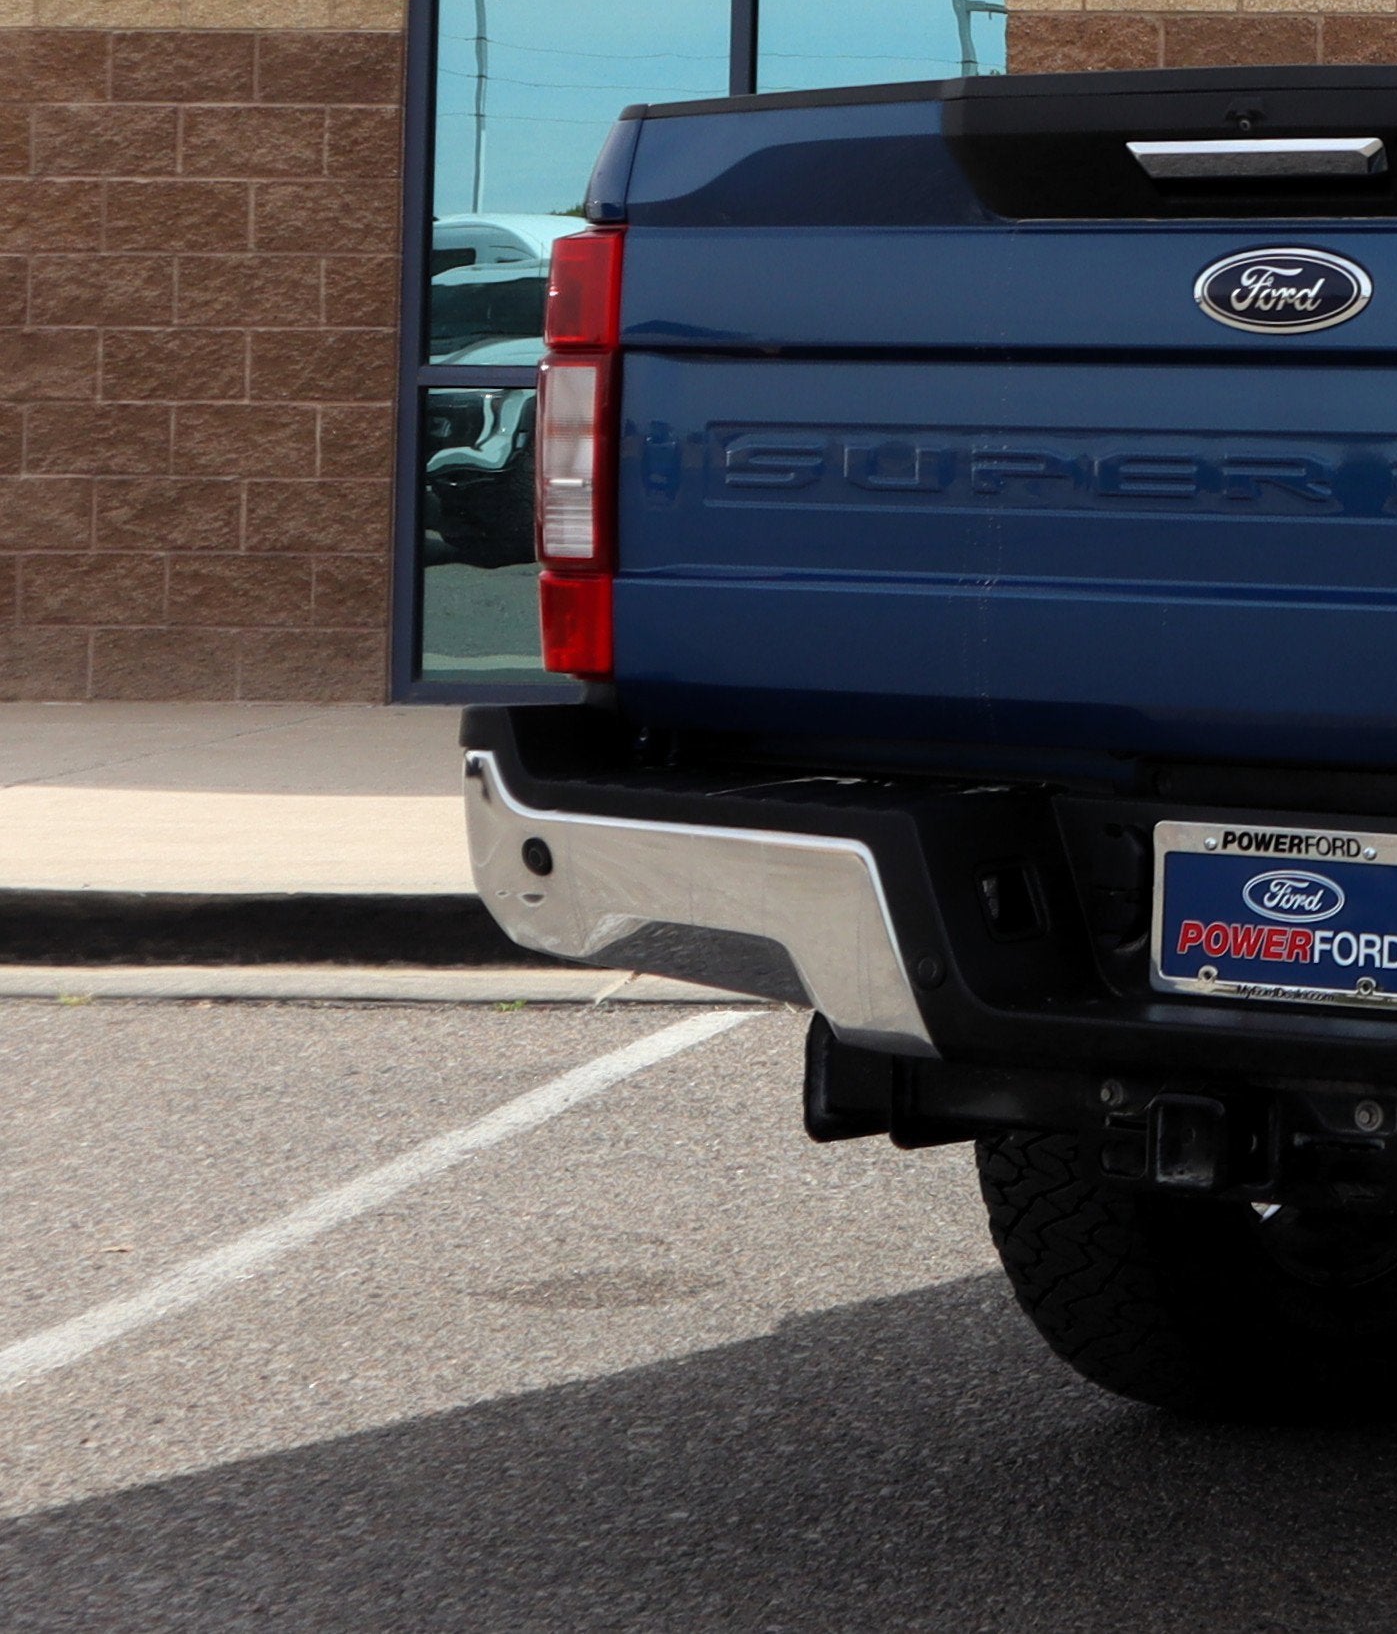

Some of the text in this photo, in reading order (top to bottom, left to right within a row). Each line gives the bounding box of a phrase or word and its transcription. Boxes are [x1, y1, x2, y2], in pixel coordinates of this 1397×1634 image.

[1230, 265, 1326, 312] Ford
[724, 435, 1333, 504] SUPER
[1221, 830, 1362, 859] POWERFORD
[1262, 877, 1325, 913] Ford
